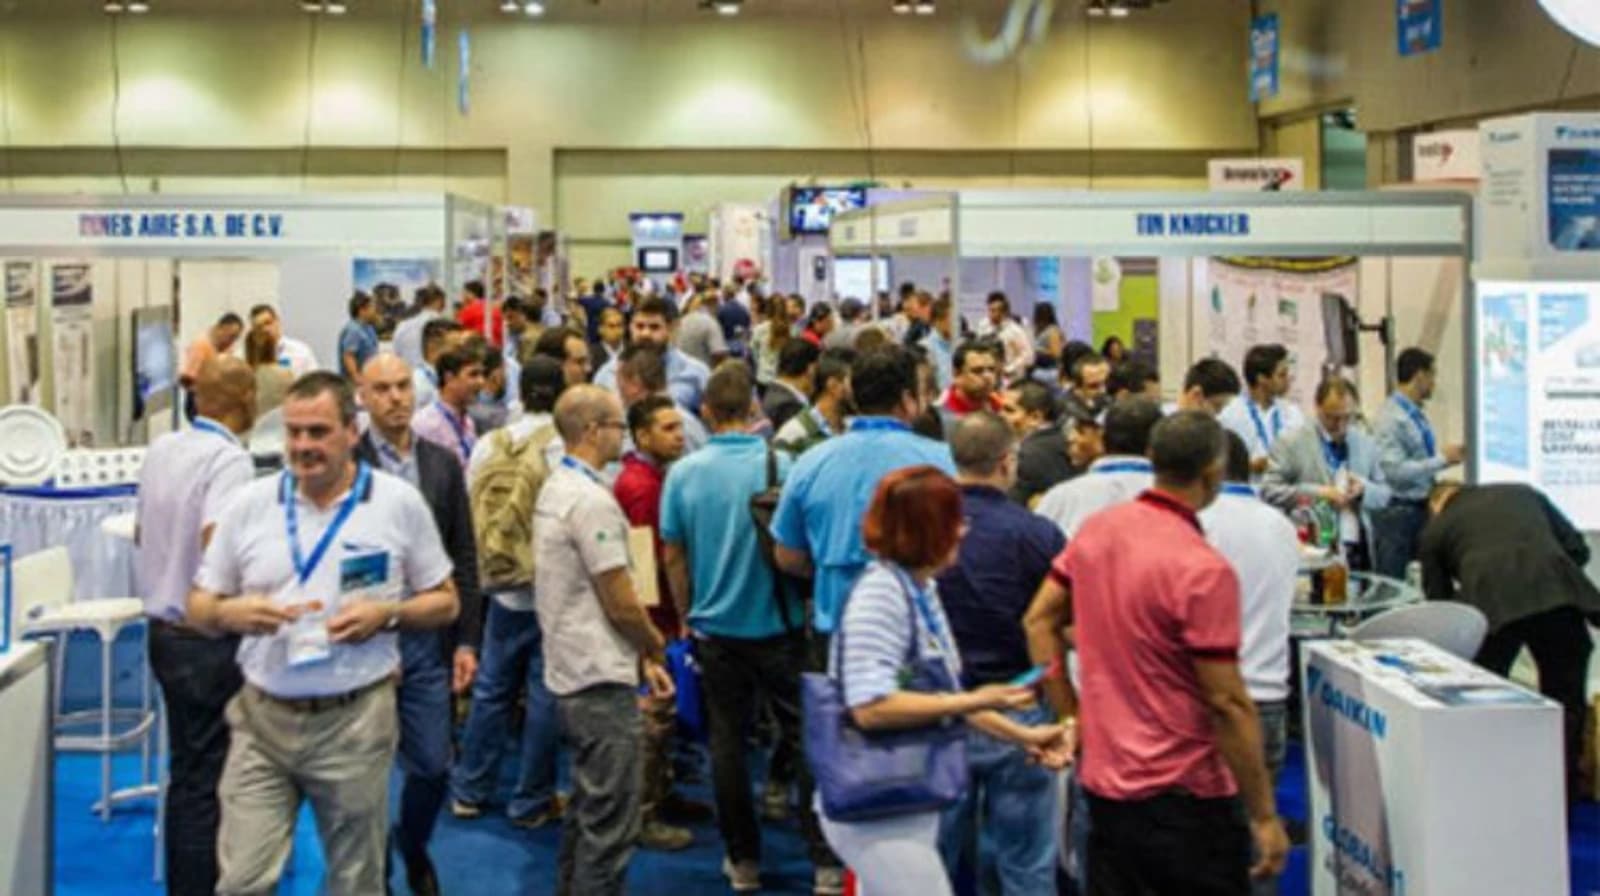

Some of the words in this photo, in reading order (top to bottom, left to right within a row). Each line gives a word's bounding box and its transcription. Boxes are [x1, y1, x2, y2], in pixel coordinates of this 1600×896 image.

[138, 213, 179, 237] AIRE
[225, 213, 245, 237] DE
[1169, 213, 1250, 236] KNOCKER
[1322, 682, 1386, 737] DAIKIN
